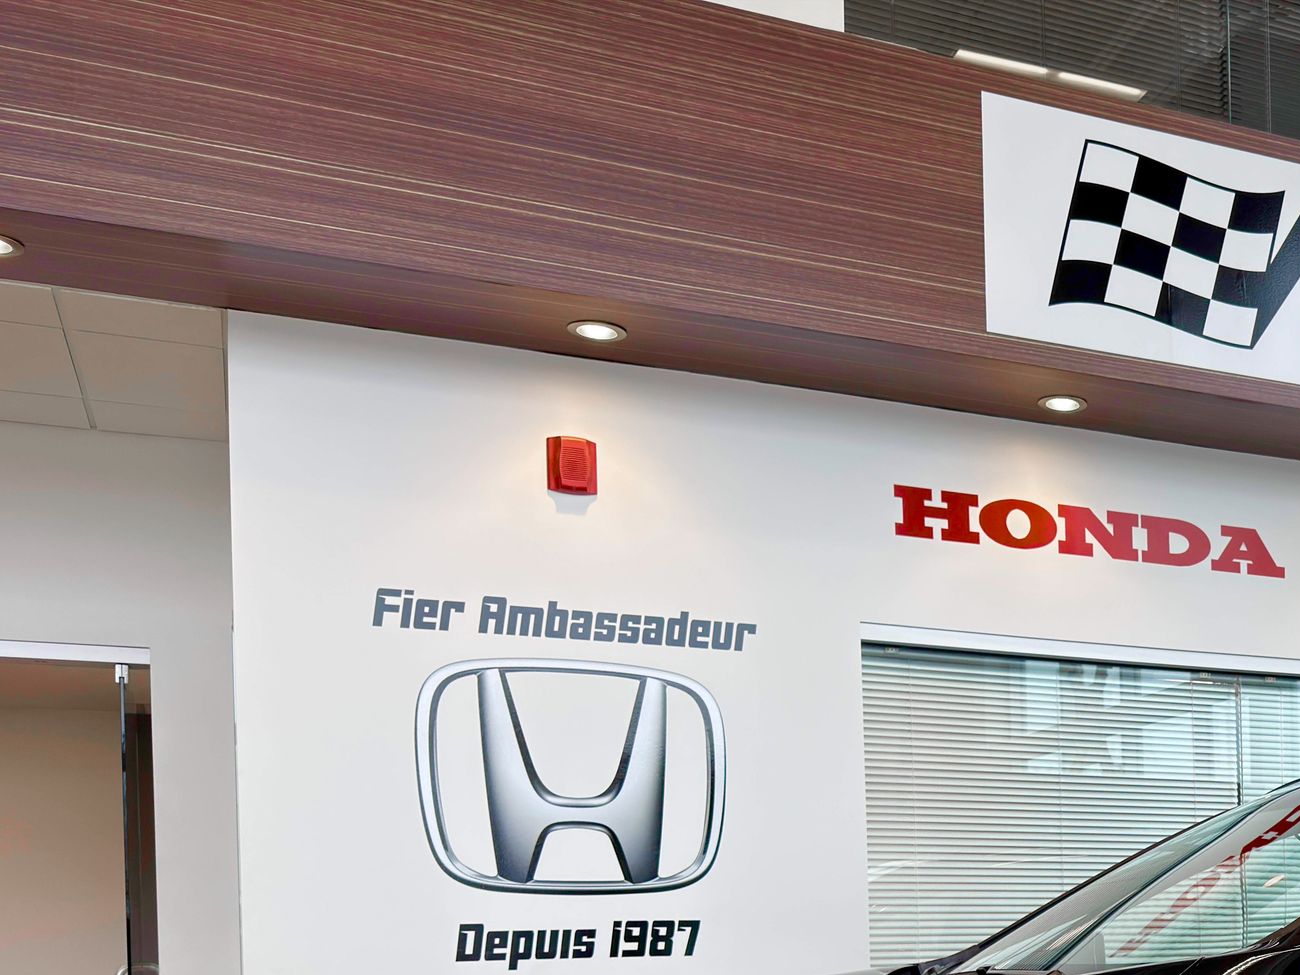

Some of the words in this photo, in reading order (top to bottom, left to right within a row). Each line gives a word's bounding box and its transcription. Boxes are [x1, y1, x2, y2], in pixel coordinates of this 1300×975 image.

[894, 484, 1286, 579] HONDA
[372, 587, 466, 632] Fier
[477, 595, 758, 652] Ambassadeur
[455, 923, 597, 971] Depuis
[609, 919, 701, 958] 1987
